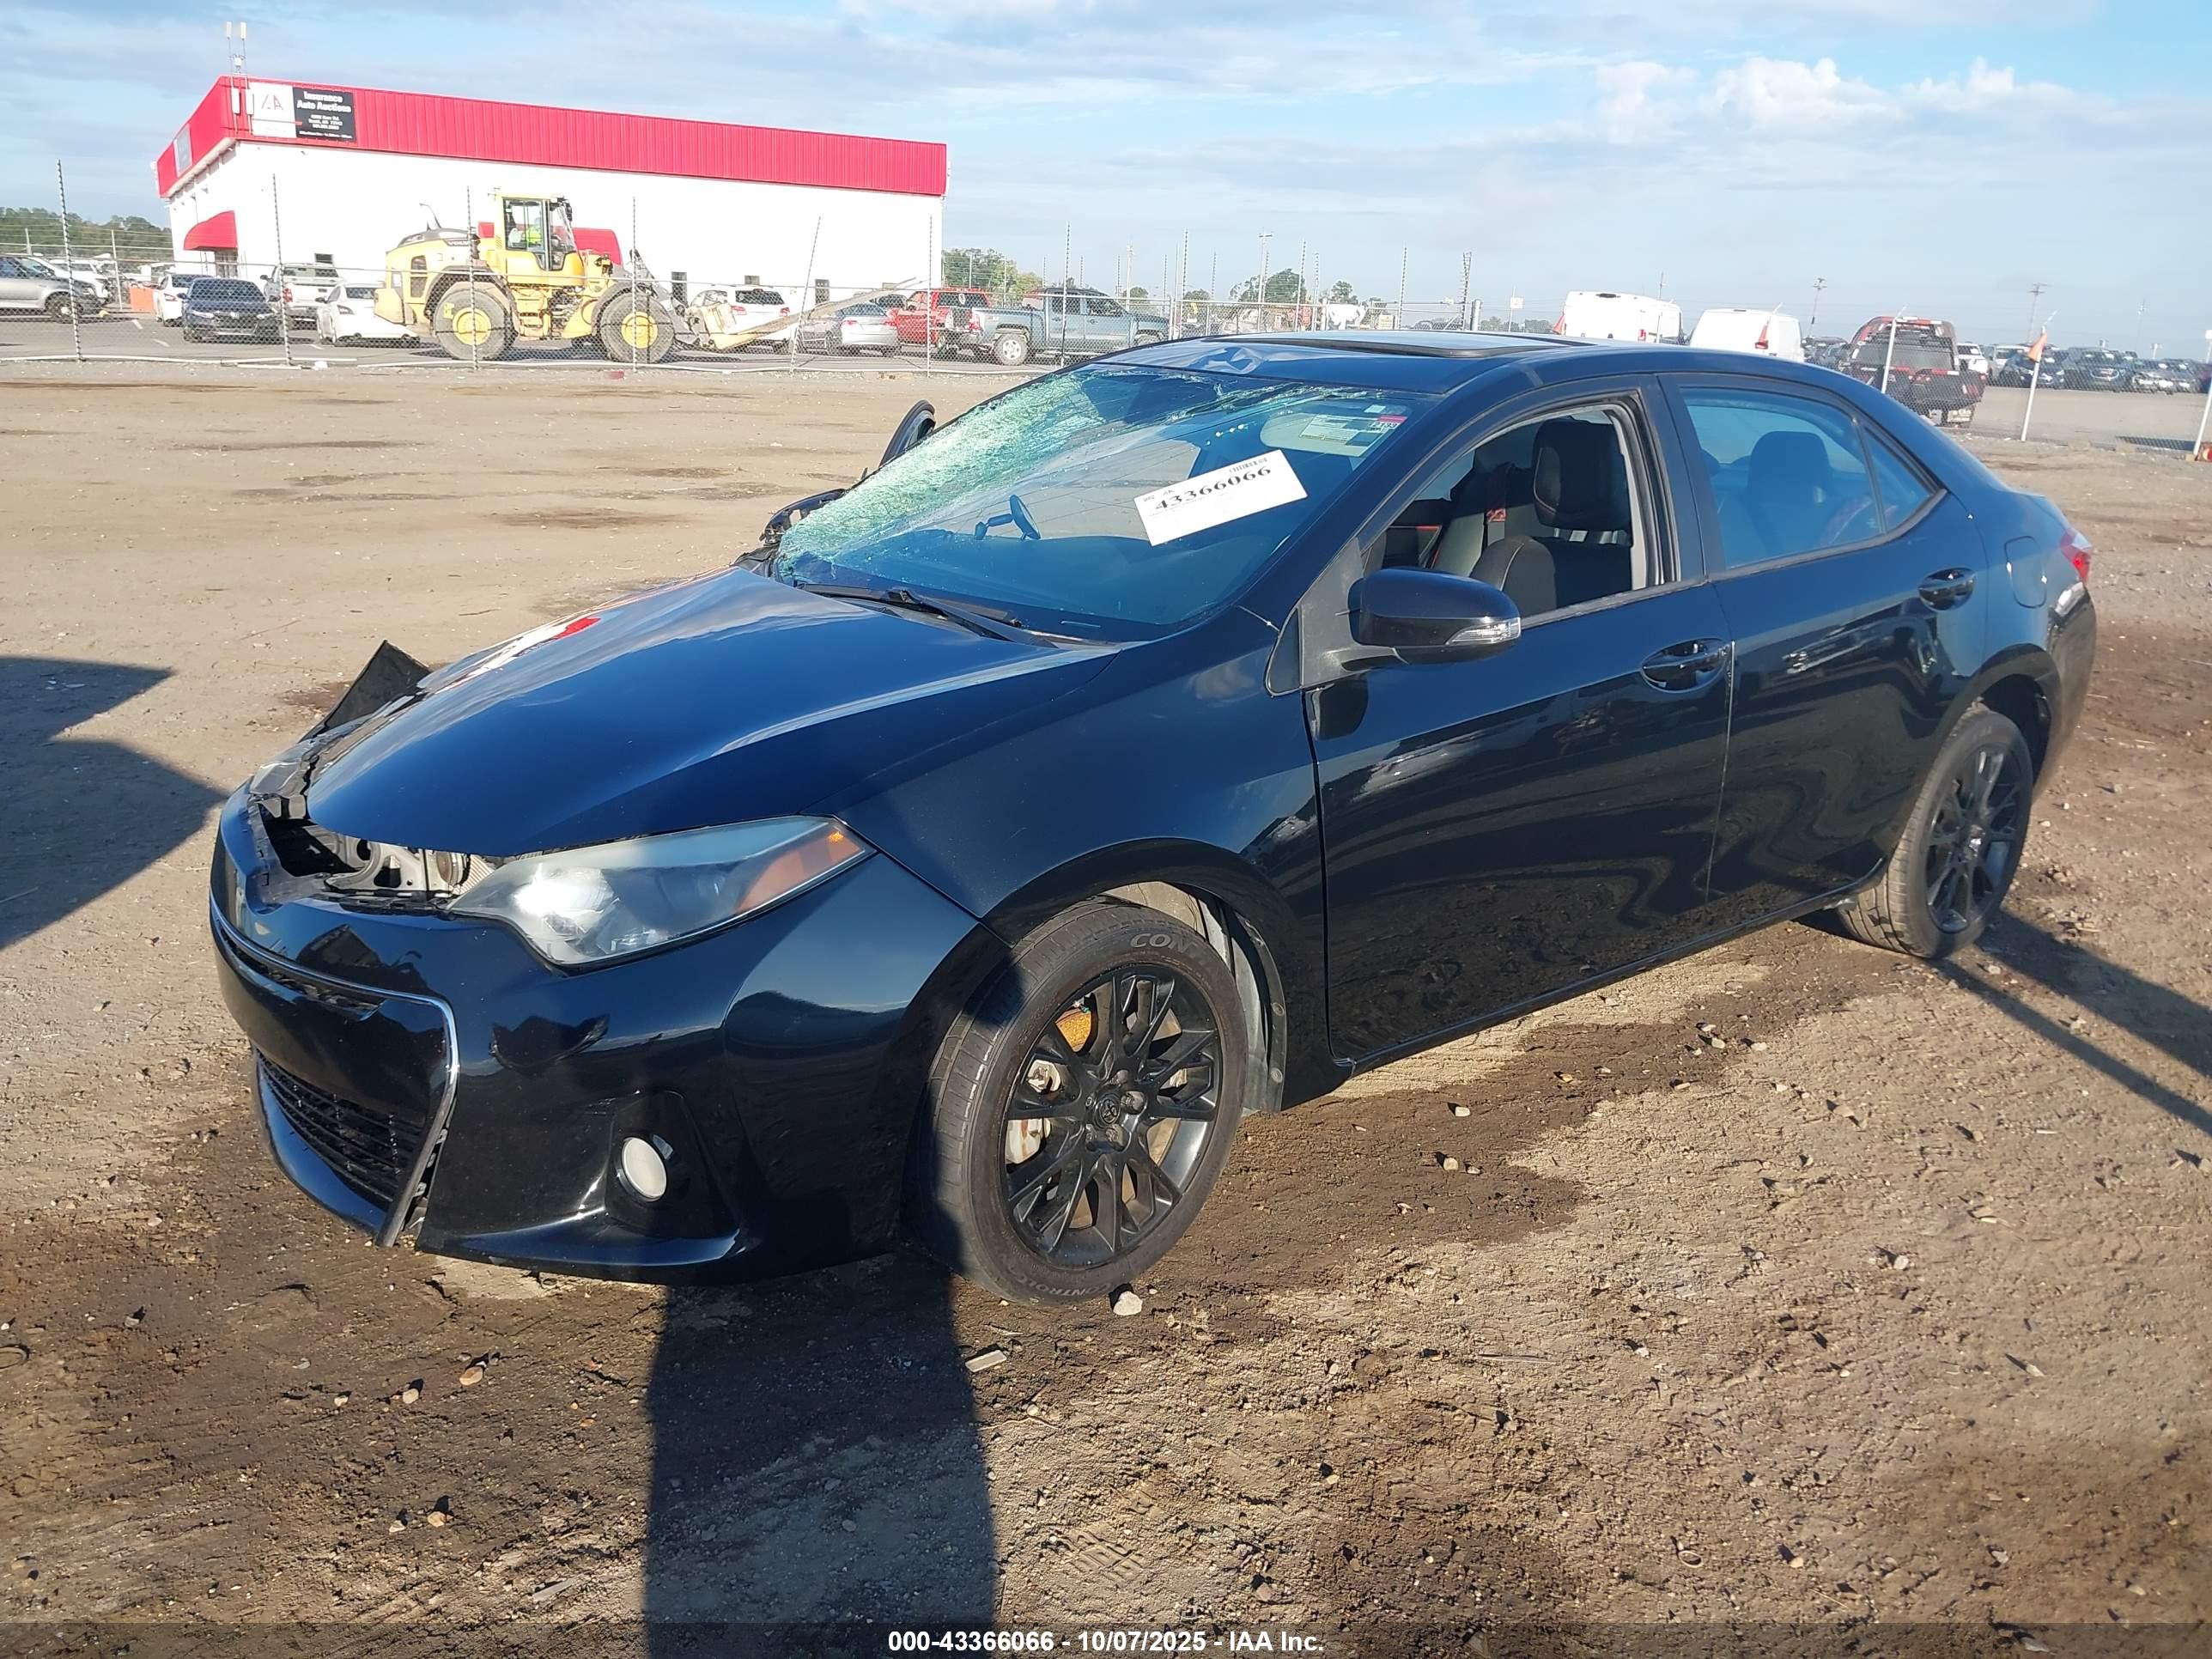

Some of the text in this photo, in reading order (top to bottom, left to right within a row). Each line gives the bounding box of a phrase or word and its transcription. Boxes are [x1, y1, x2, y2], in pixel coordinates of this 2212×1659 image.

[303, 91, 343, 103] Insurance
[296, 100, 316, 110] Auto
[317, 101, 352, 112] Auctions
[1155, 466, 1272, 509] 43366066
